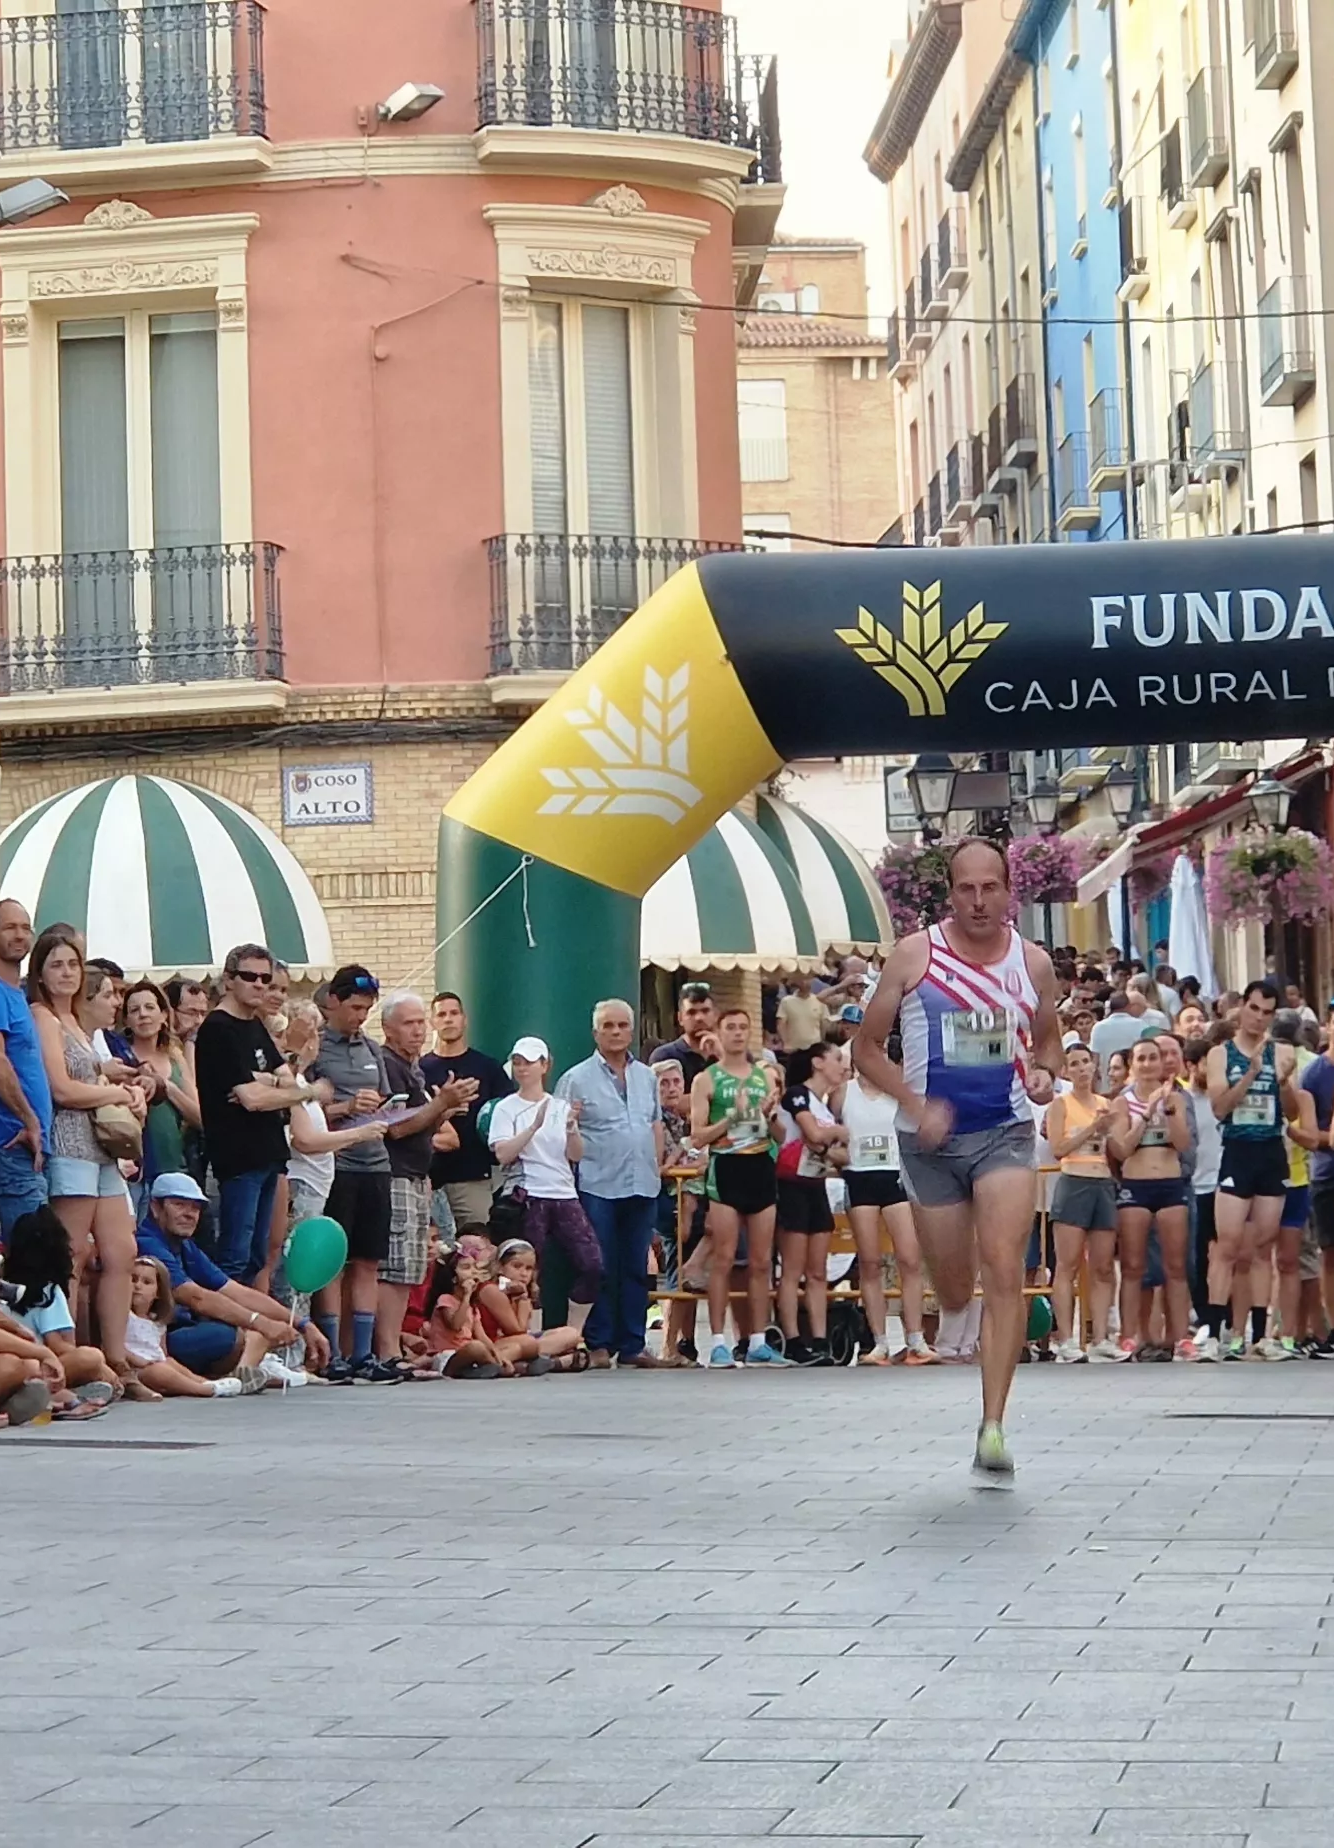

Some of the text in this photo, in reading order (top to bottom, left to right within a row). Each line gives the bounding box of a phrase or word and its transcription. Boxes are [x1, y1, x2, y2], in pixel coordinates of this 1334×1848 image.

[984, 677, 1118, 714] CAJA
[1137, 669, 1307, 707] RURAL
[313, 773, 358, 787] COSO
[296, 800, 362, 816] ALTO
[967, 1011, 995, 1032] 10
[1248, 1096, 1263, 1106] 13
[866, 1136, 883, 1148] 18
